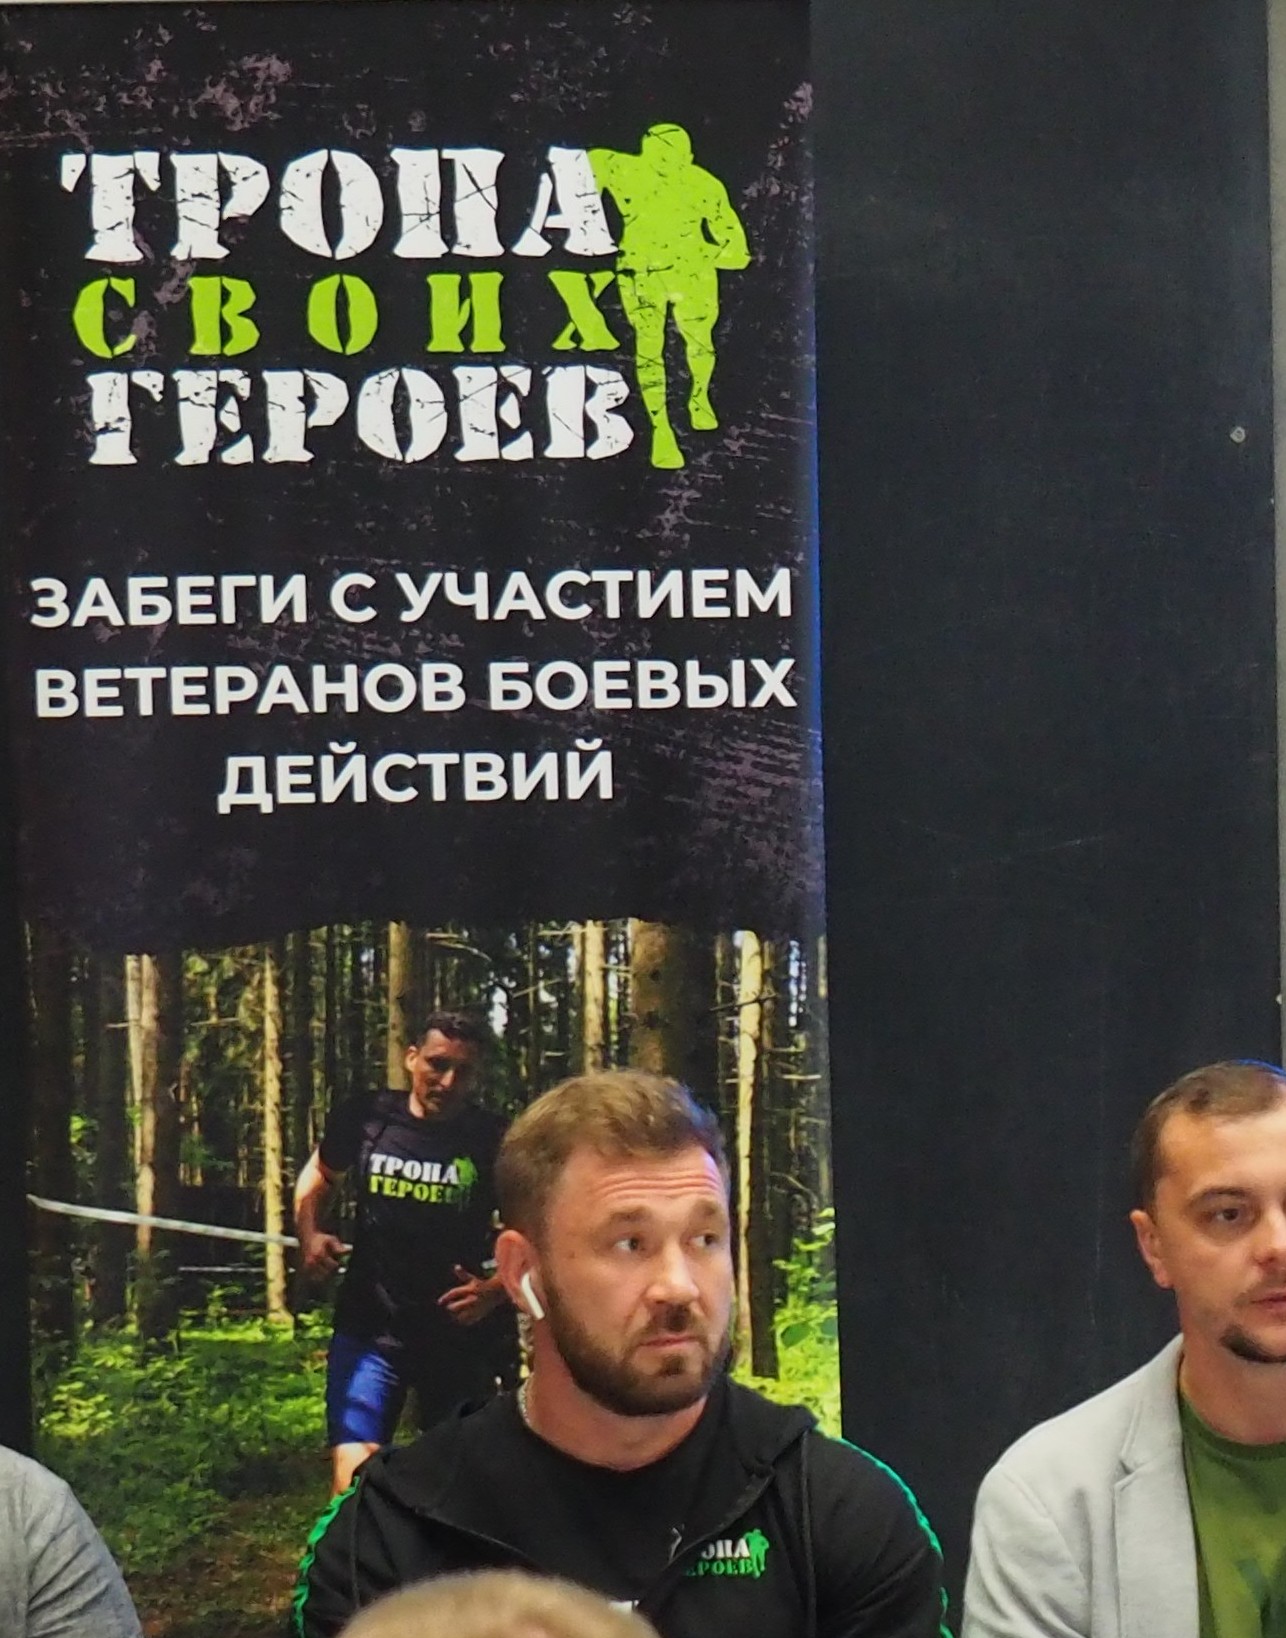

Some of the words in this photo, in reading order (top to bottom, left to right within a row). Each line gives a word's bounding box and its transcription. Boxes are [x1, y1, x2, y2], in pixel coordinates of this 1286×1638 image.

[60, 147, 619, 262] ТРОПА
[71, 272, 621, 358] СВОИХ
[87, 366, 635, 466] ГЕРОЕВ
[30, 574, 308, 628] ЗАБЕГИ
[330, 572, 376, 624] С
[396, 568, 793, 624] УЧАСТИЕМ
[34, 662, 466, 718] ВЕТЕРАНОВ
[489, 658, 798, 712] БОЕВЫХ
[217, 739, 615, 815] ДЕЙСТВИЙ
[369, 1152, 460, 1185] ТРОПА
